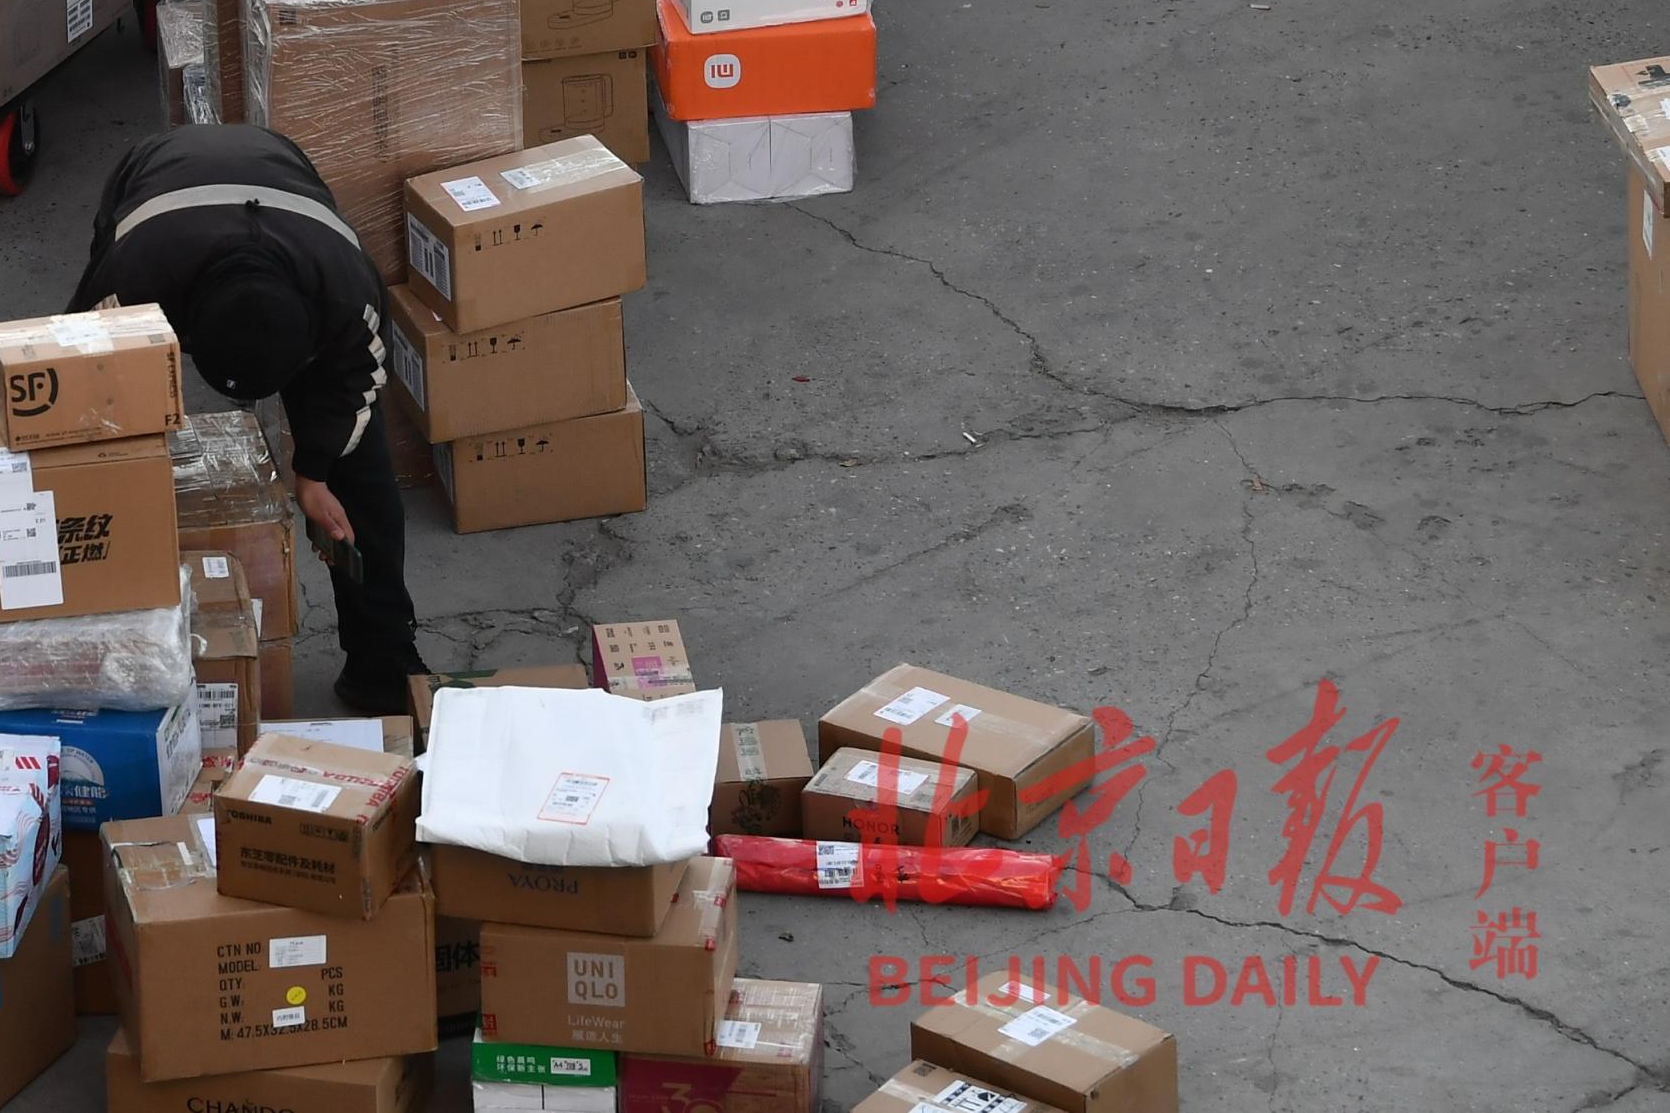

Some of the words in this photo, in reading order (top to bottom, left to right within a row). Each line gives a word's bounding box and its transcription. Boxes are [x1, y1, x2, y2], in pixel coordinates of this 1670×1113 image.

[164, 413, 182, 426] F2
[58, 513, 113, 544] 条纹
[842, 816, 899, 834] HONOR
[508, 872, 578, 894] PROYA
[217, 944, 242, 958] CTN
[246, 942, 261, 955] NO
[321, 967, 343, 980] PCS
[573, 959, 615, 979] UNI
[328, 983, 344, 997] KG
[574, 980, 619, 1001] QLO
[329, 1000, 344, 1013] KG
[567, 1014, 625, 1029] LifeWear
